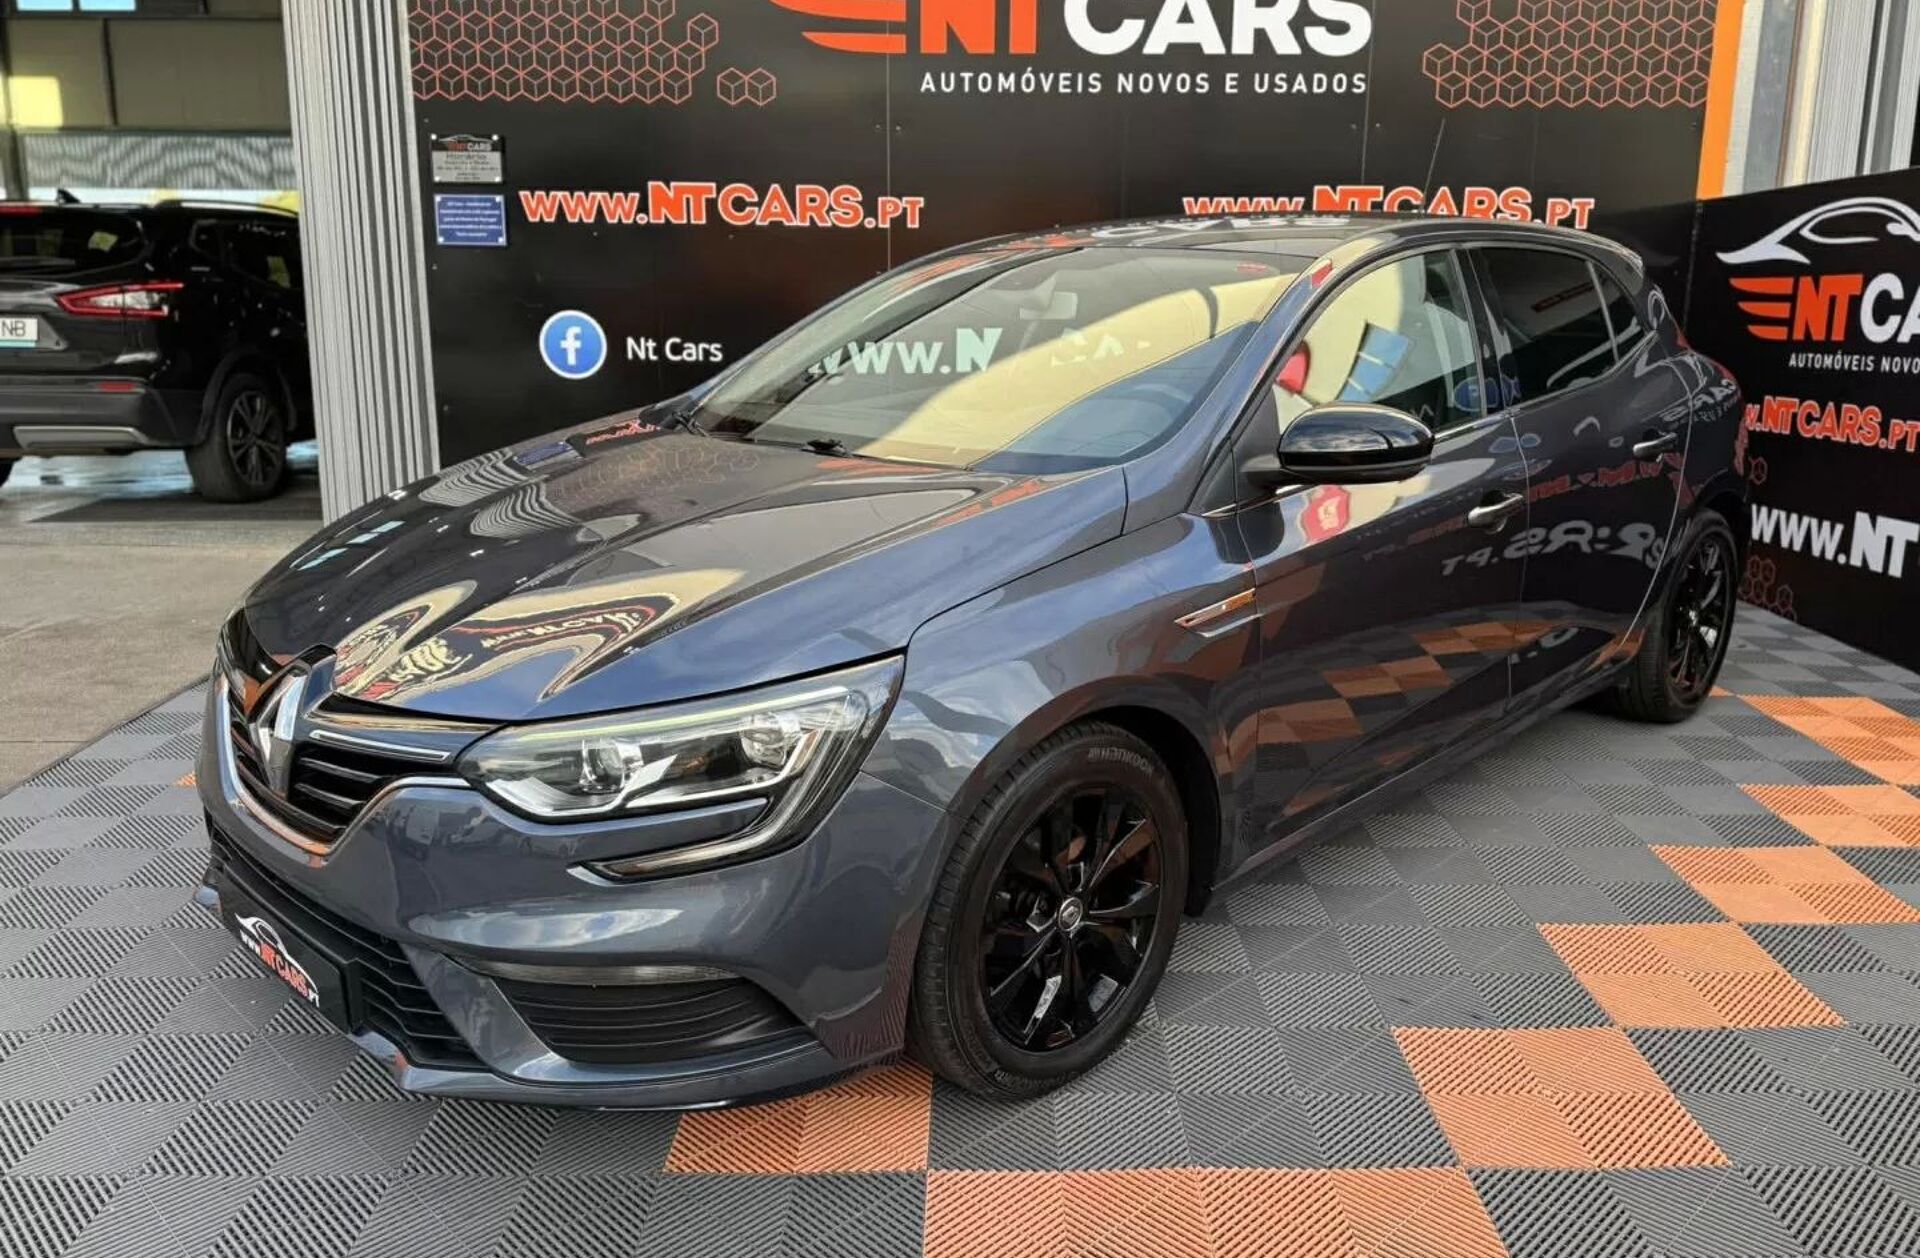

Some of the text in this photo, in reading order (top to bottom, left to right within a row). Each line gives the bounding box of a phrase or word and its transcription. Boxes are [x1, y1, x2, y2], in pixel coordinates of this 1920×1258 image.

[920, 67, 1367, 94] AUTOMÓVEIS NOVOS E USADOS
[626, 336, 724, 362] Nt Cars
[1788, 349, 1876, 372] AUTOMÓVEIS
